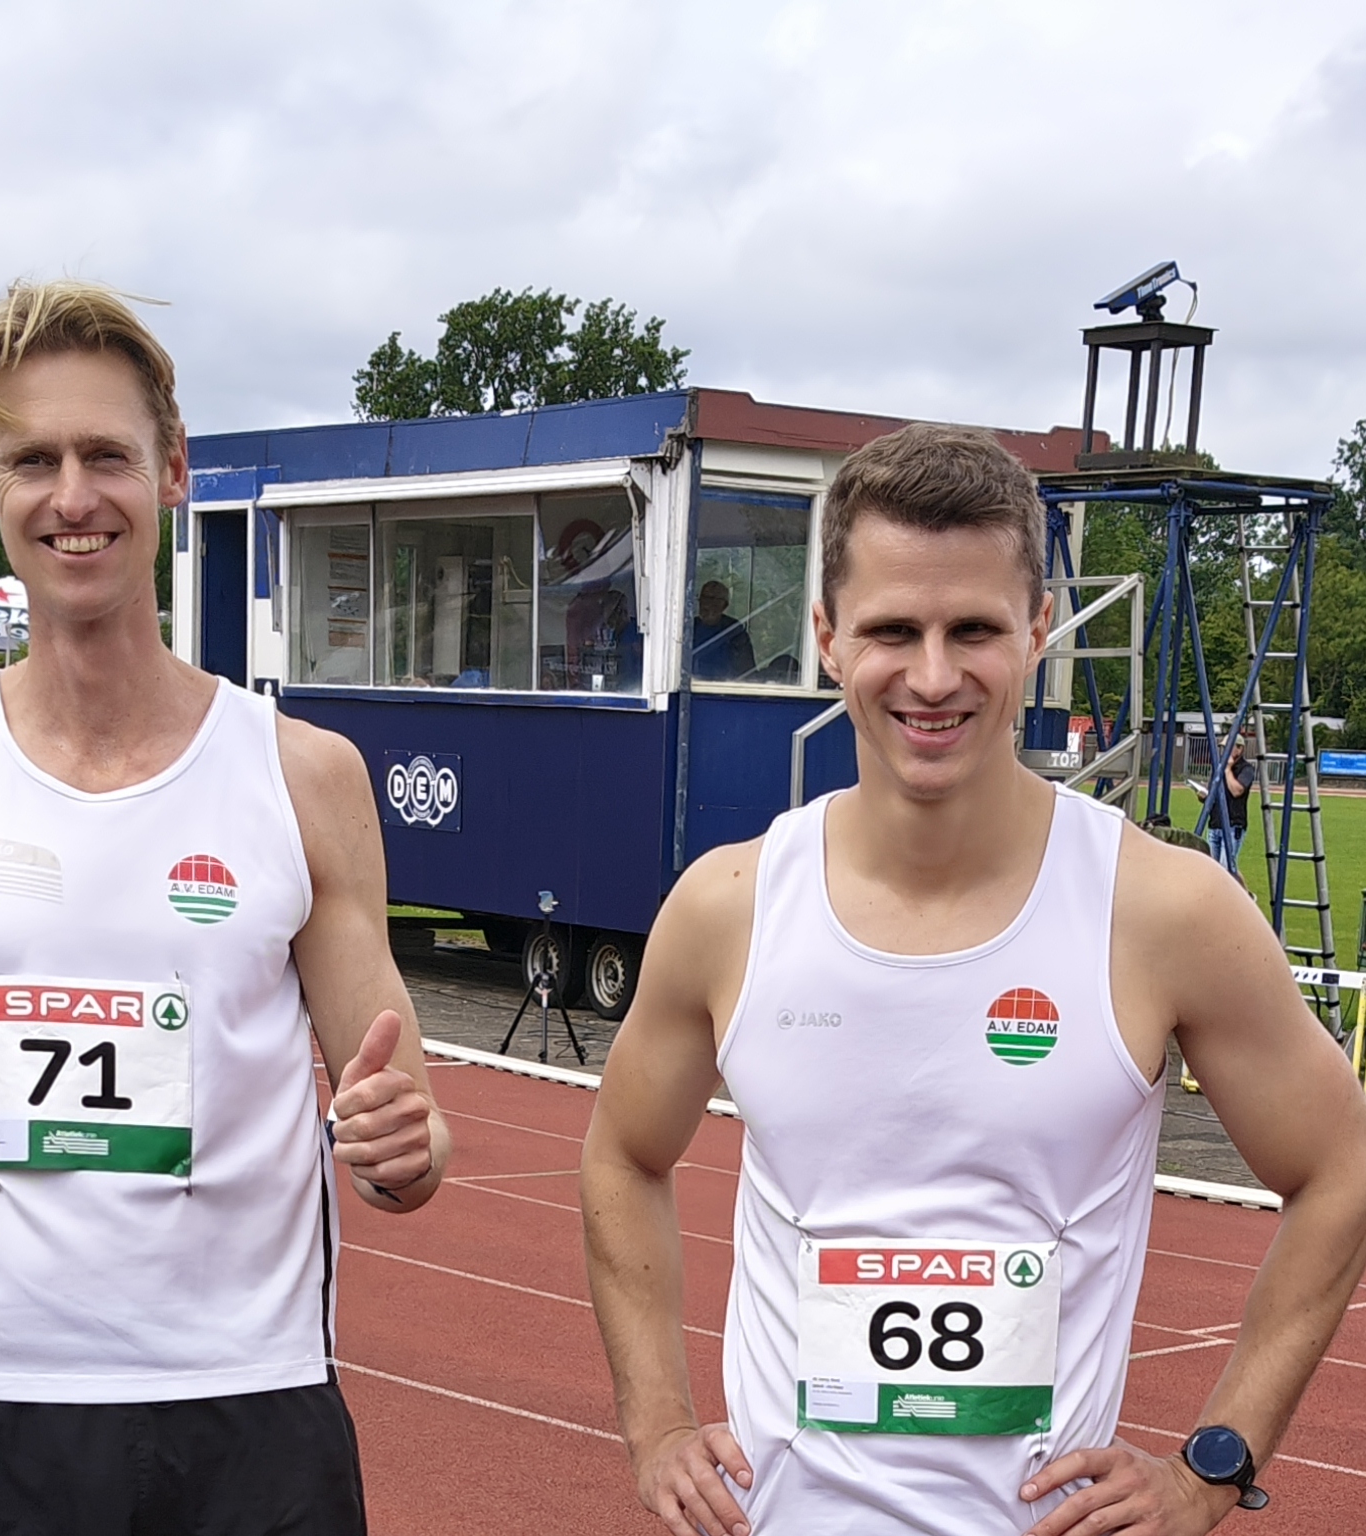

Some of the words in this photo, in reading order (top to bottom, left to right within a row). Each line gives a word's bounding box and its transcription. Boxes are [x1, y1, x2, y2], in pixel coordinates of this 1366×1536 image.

[197, 884, 236, 899] EDAM
[5, 990, 141, 1022] SPAR
[798, 1012, 842, 1028] JAKO
[1016, 1021, 1058, 1035] EDAM
[20, 1038, 133, 1111] 71
[856, 1253, 993, 1280] SPAR
[868, 1300, 985, 1372] 68
